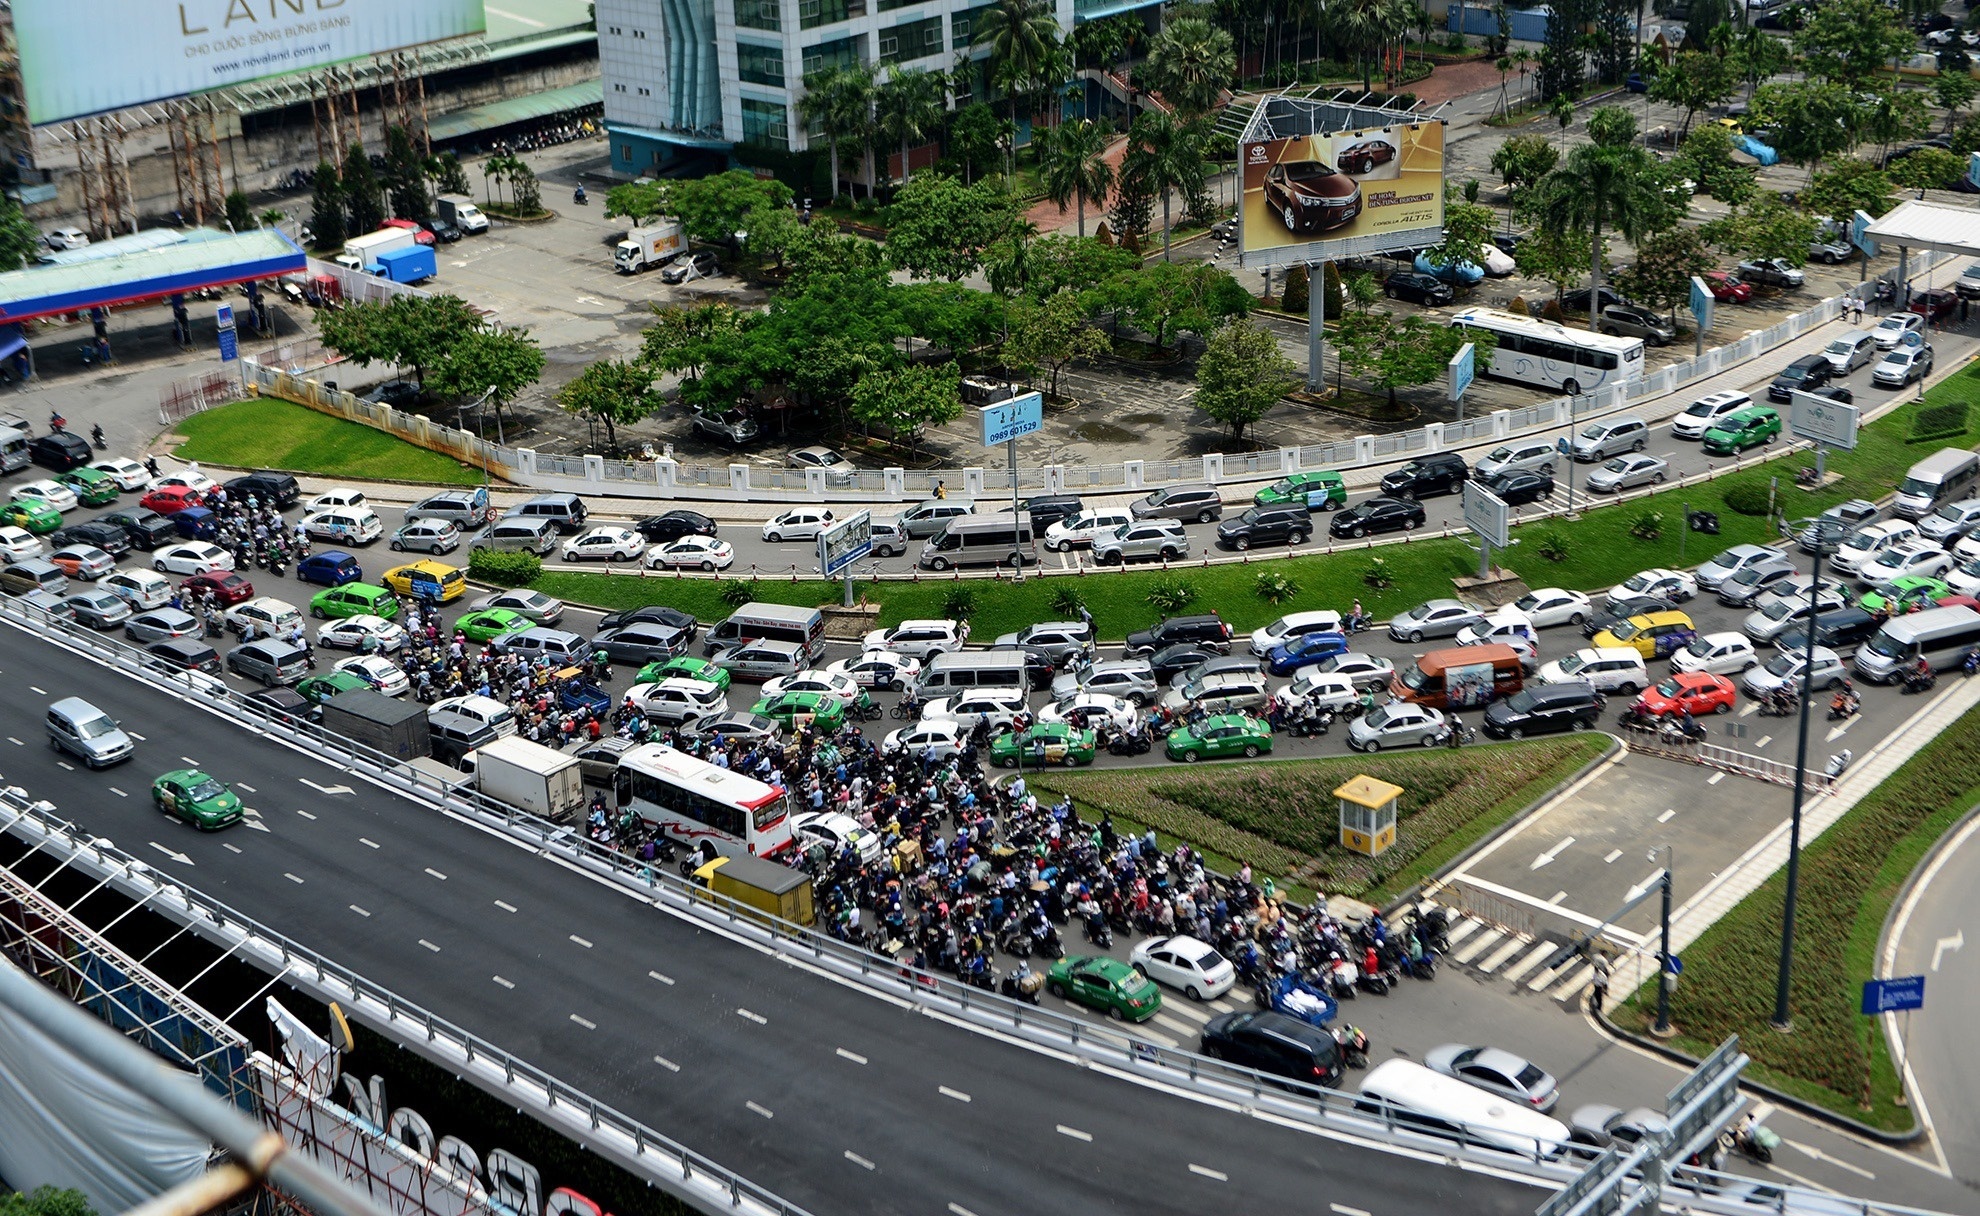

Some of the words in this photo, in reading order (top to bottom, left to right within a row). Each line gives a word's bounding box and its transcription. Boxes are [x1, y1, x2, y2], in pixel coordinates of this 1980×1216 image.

[184, 45, 210, 59] CHO
[212, 42, 331, 74] www.novaland.com.vn
[1400, 213, 1433, 223] ALTIS
[990, 430, 1008, 442] 0989
[1010, 421, 1037, 436] 601529
